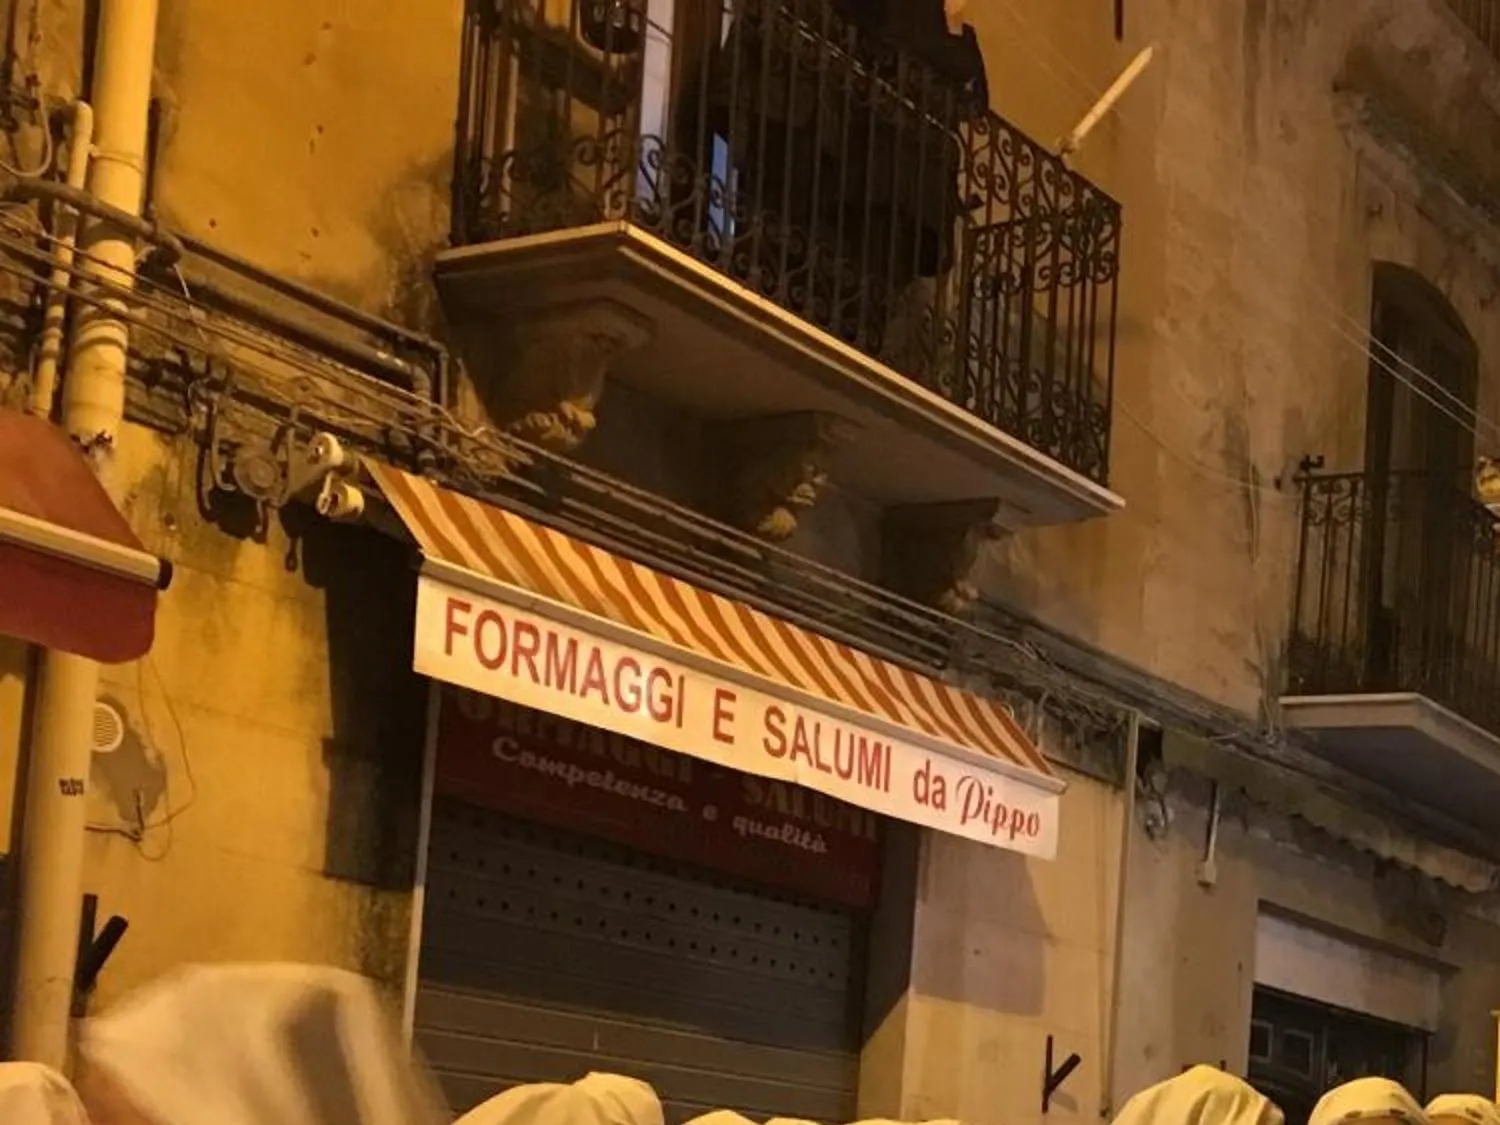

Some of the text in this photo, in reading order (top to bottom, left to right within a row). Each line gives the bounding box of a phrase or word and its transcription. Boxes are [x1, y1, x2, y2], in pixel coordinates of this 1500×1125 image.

[445, 597, 1040, 840] FORMAGGI E SALUMI da Pippo
[491, 735, 829, 853] Competenza e qualità
